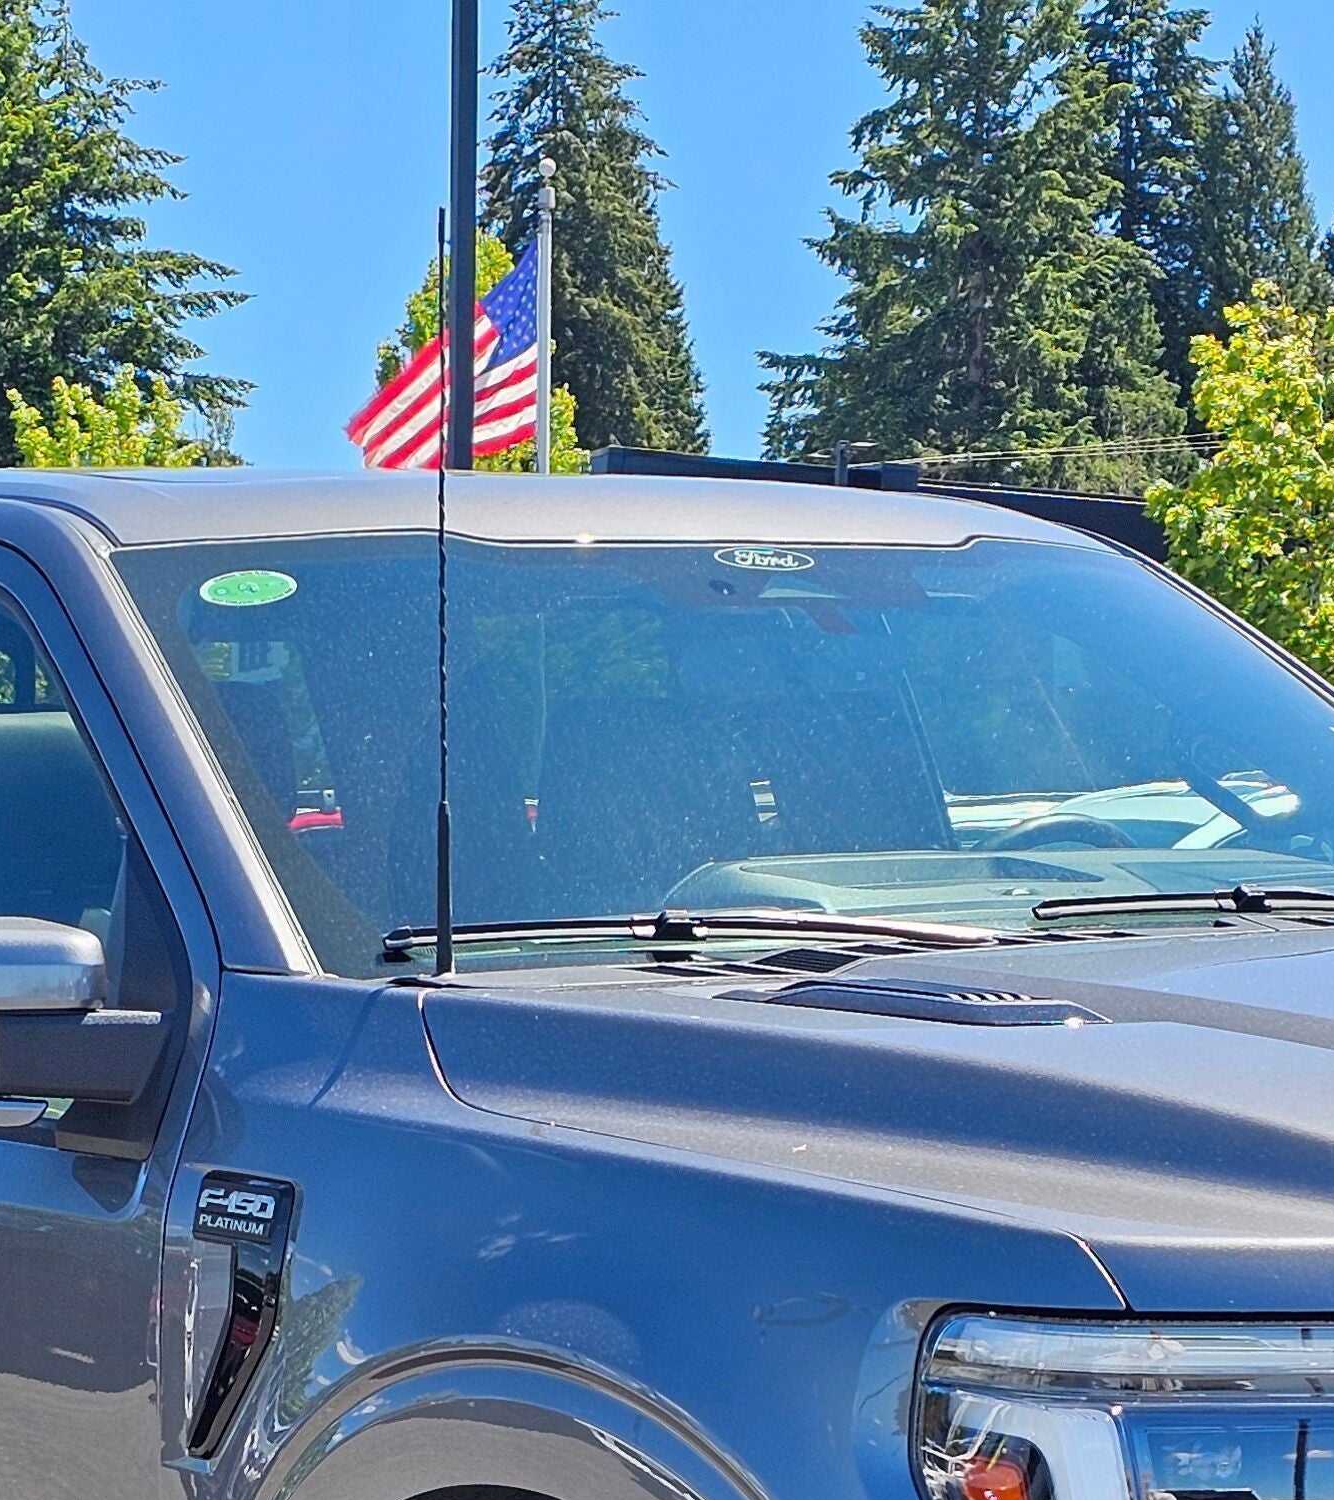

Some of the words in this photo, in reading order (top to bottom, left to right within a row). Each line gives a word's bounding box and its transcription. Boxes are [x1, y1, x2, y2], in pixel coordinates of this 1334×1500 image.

[733, 549, 798, 567] Ford
[198, 1188, 275, 1219] F-150
[199, 1213, 265, 1236] PLATINUM
